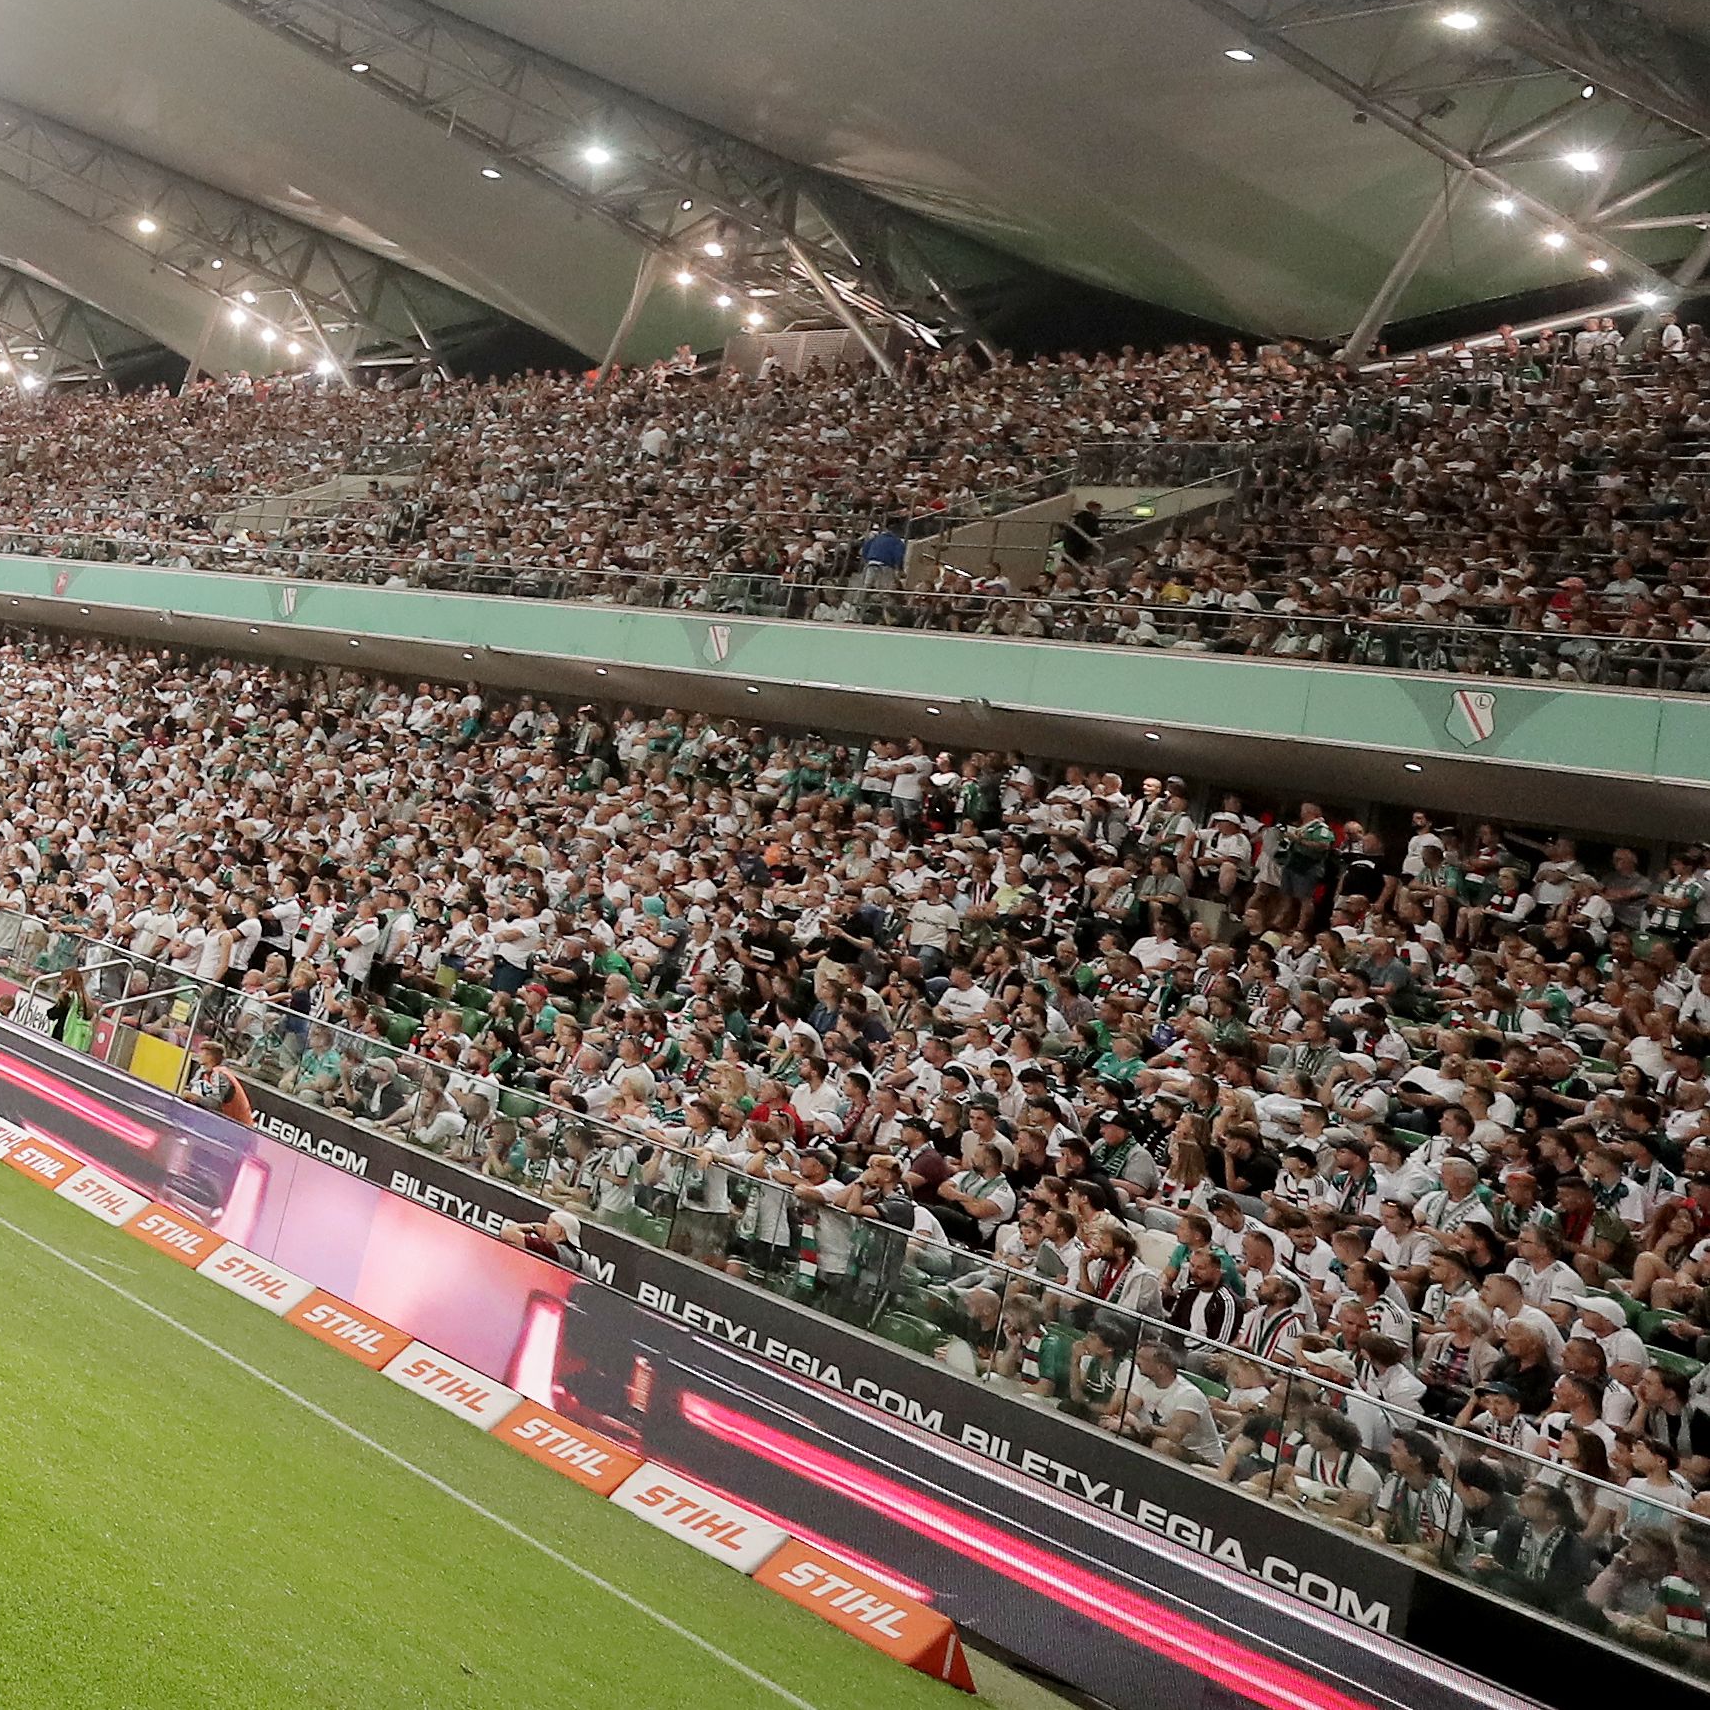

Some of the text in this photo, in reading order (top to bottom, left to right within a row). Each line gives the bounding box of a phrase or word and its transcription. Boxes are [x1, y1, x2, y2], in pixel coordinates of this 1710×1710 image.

[13, 1147, 66, 1180] STIHL
[72, 1178, 131, 1216] STIHL
[136, 1213, 205, 1256] STIHL
[215, 1256, 290, 1301] STIHL
[302, 1304, 387, 1355] STIHL
[402, 1358, 494, 1414] STIHL
[512, 1416, 614, 1479] STIHL
[637, 1281, 945, 1434] BILETY.LEGIA.COM
[961, 1423, 1391, 1634] BILETY.LEGIA.COM
[632, 1485, 753, 1551] STIHL
[778, 1560, 915, 1639] STIHL
